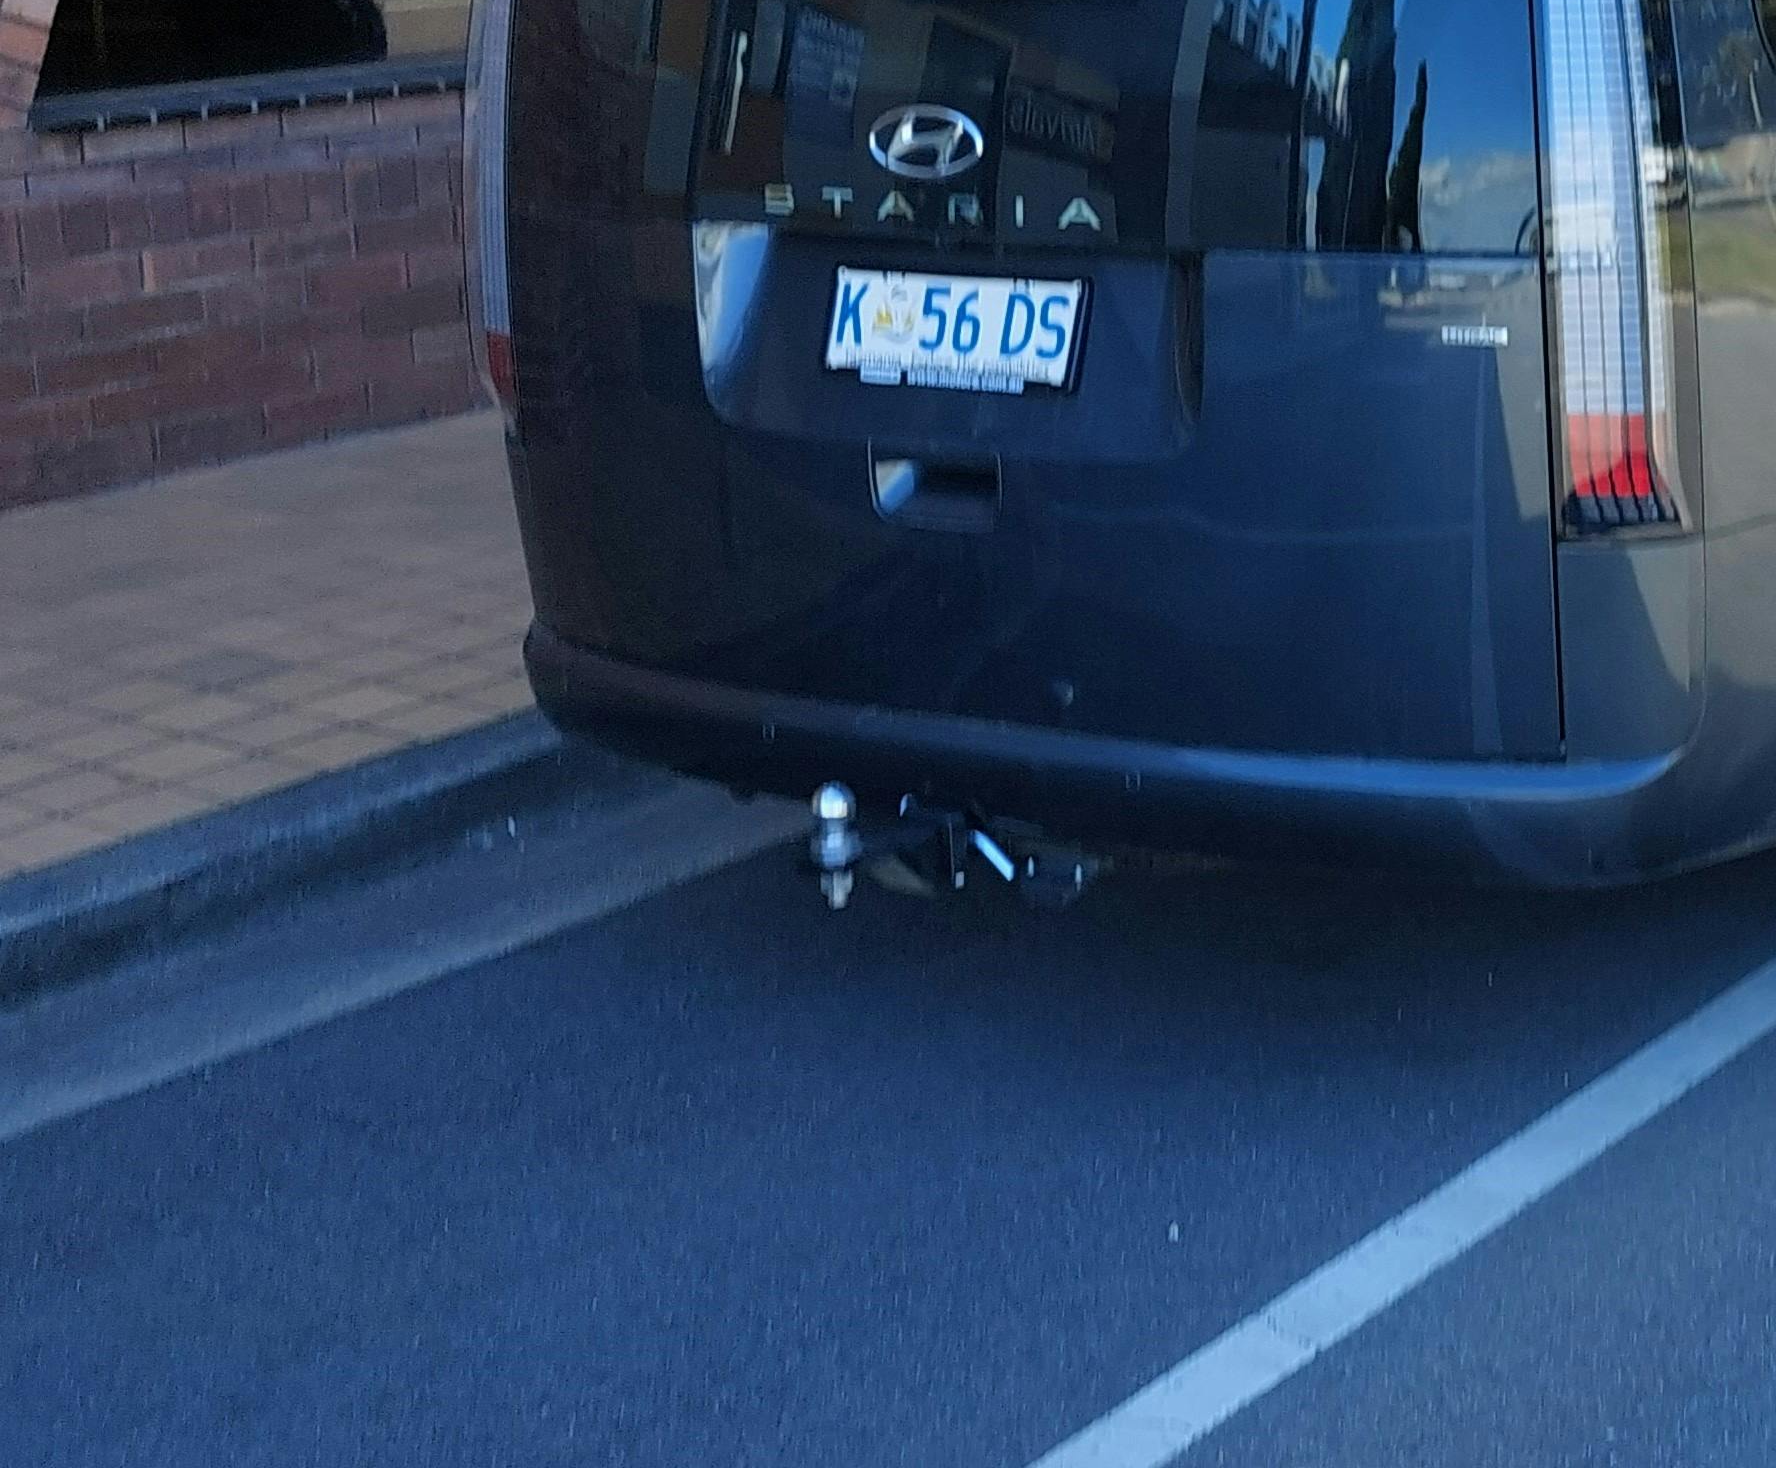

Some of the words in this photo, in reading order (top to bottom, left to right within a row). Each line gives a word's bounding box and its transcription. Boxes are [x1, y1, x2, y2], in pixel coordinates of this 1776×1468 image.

[764, 183, 1101, 231] STARIA
[835, 282, 869, 345] K
[918, 285, 981, 355] 56
[999, 292, 1071, 360] DS
